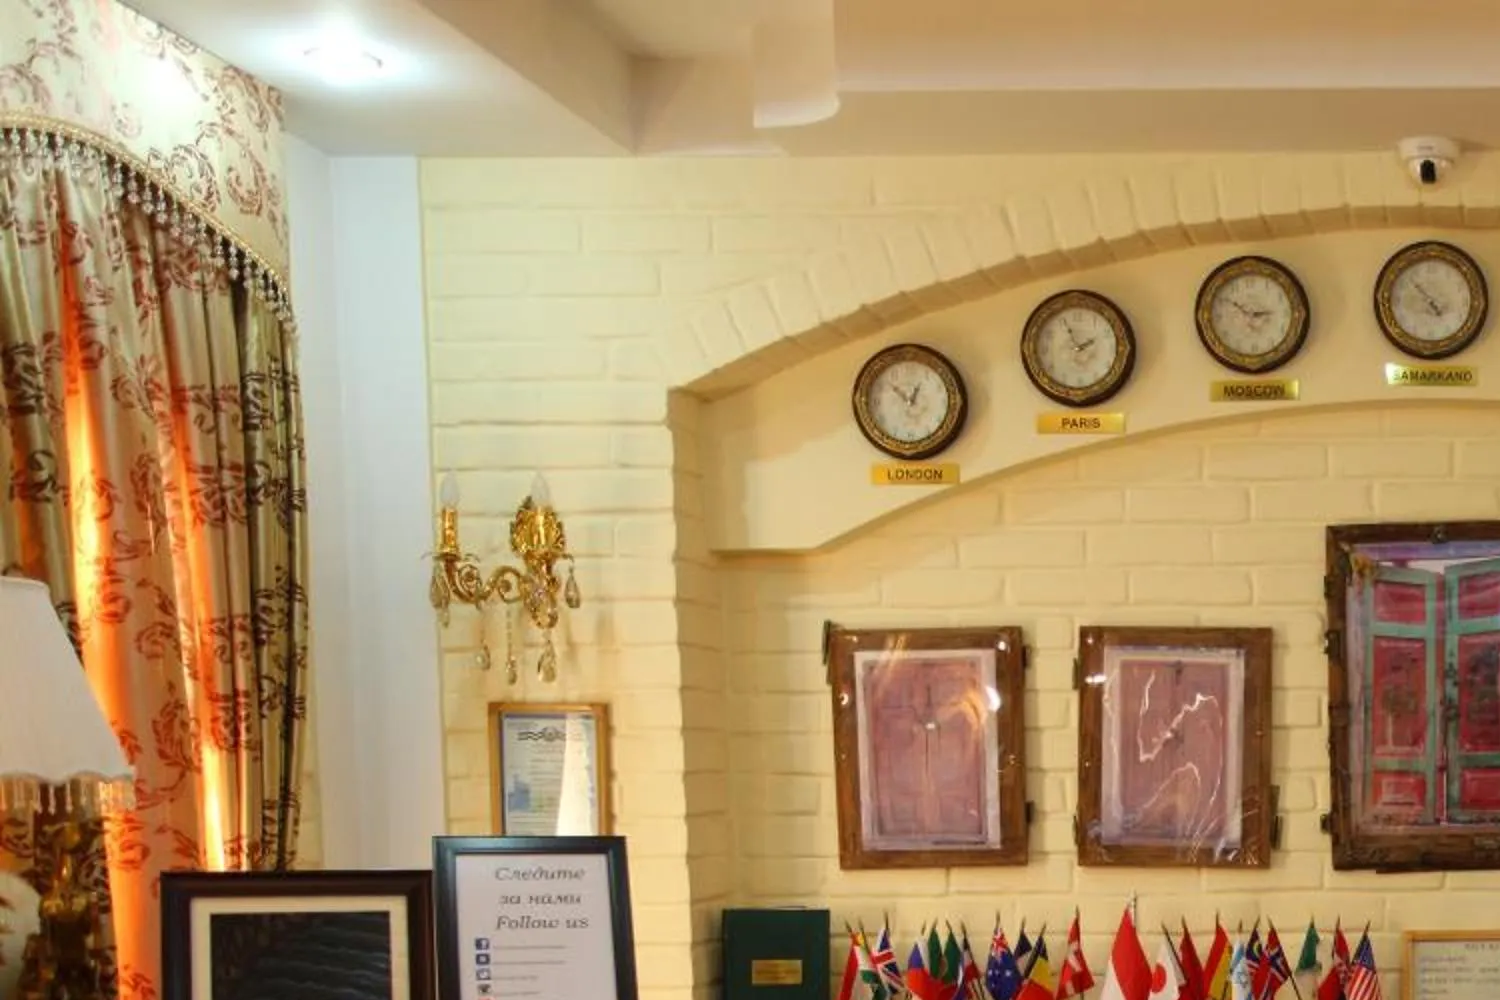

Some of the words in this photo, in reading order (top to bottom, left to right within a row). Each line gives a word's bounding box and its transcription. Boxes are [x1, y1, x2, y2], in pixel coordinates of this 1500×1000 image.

[1223, 384, 1285, 397] MOSCOW
[1061, 417, 1101, 429] PARIS
[886, 468, 943, 481] LONDON
[495, 915, 560, 931] Follow
[565, 918, 590, 930] us
